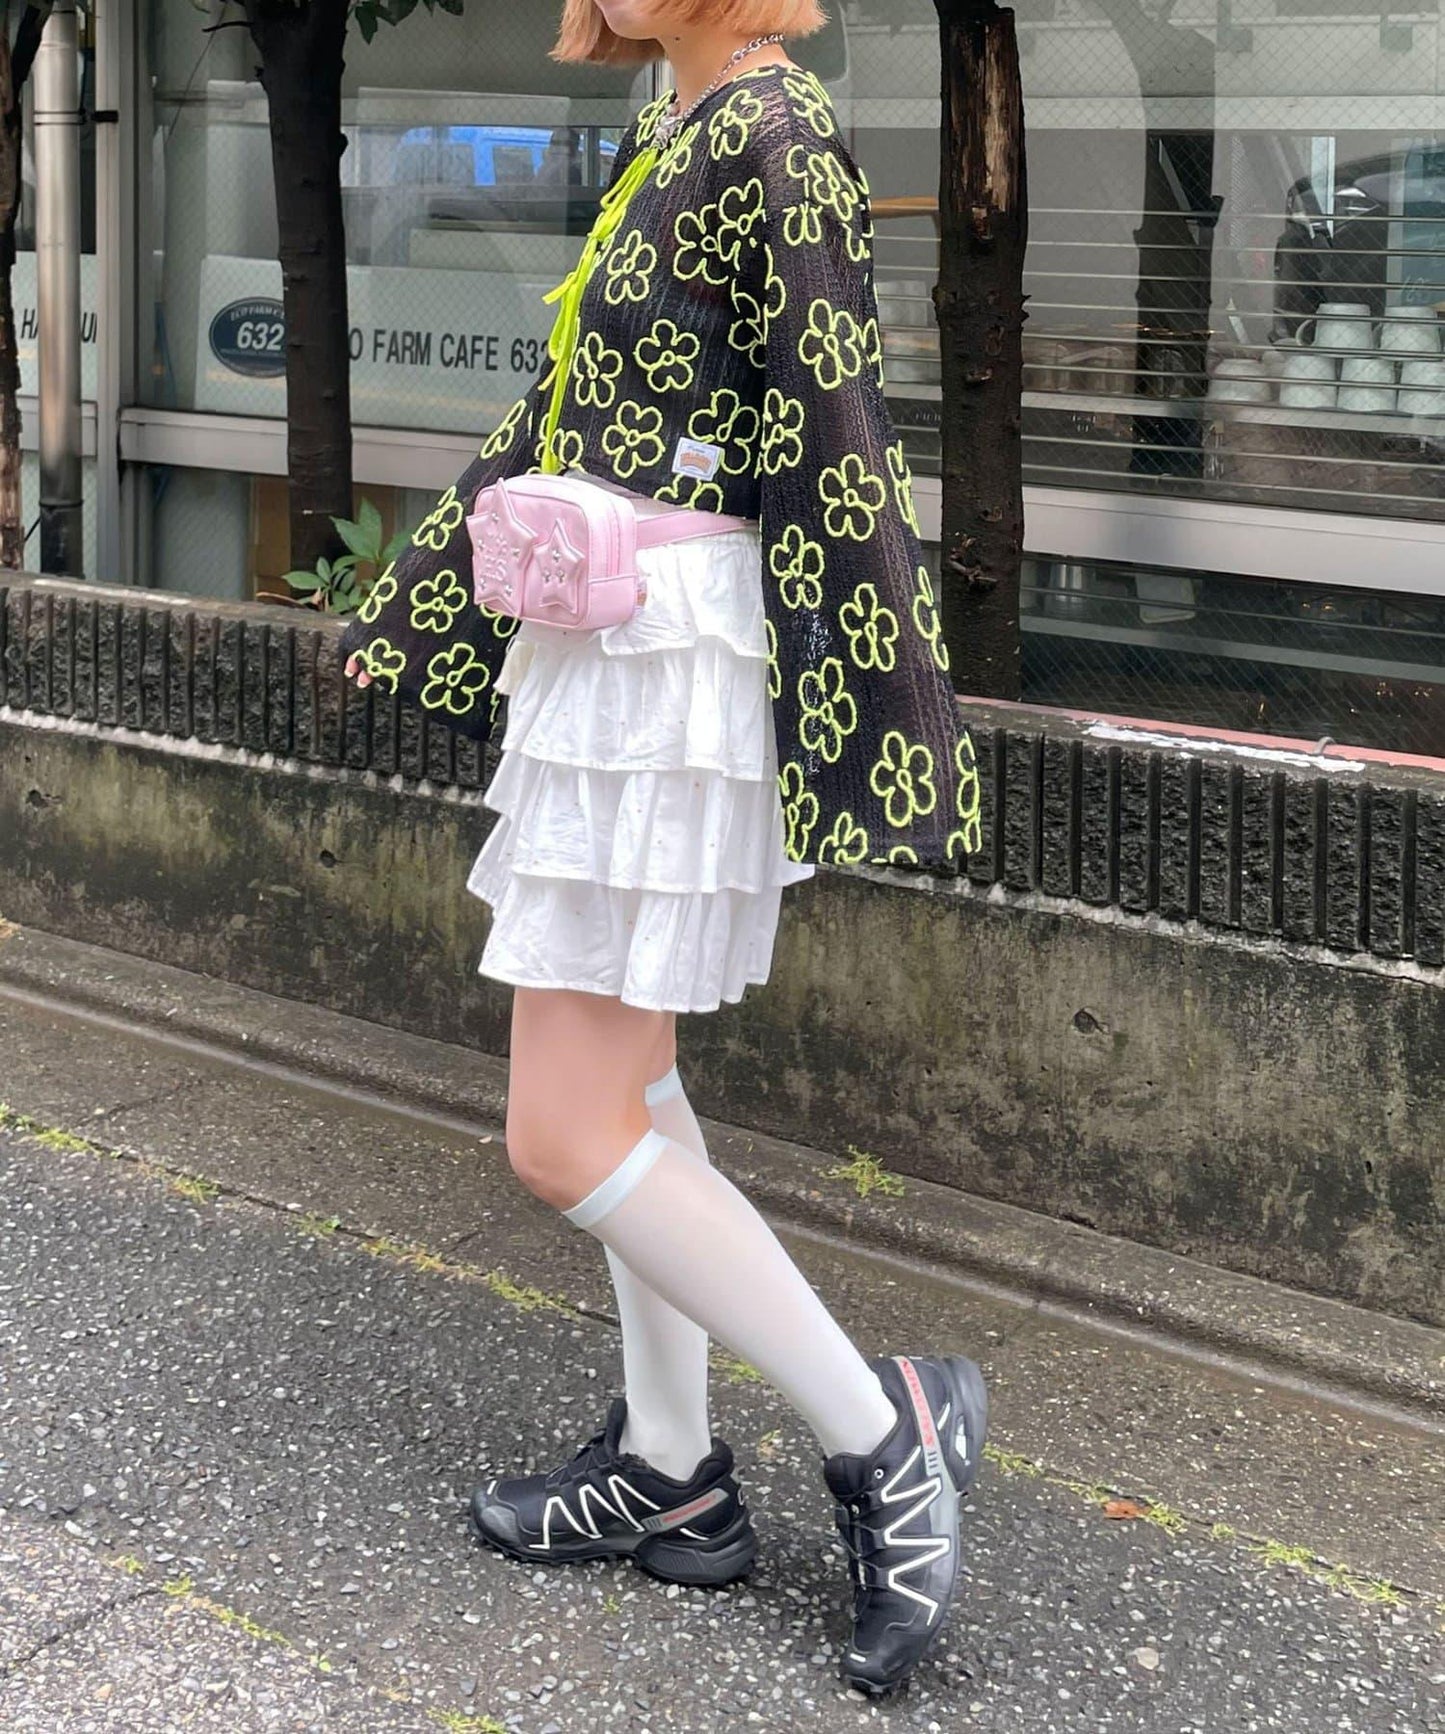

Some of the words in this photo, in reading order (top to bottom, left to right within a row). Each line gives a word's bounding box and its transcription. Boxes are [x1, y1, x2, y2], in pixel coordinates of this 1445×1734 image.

[236, 321, 285, 351] 632
[373, 329, 432, 366] FARM
[440, 333, 500, 371] CAFE
[510, 338, 550, 374] 63
